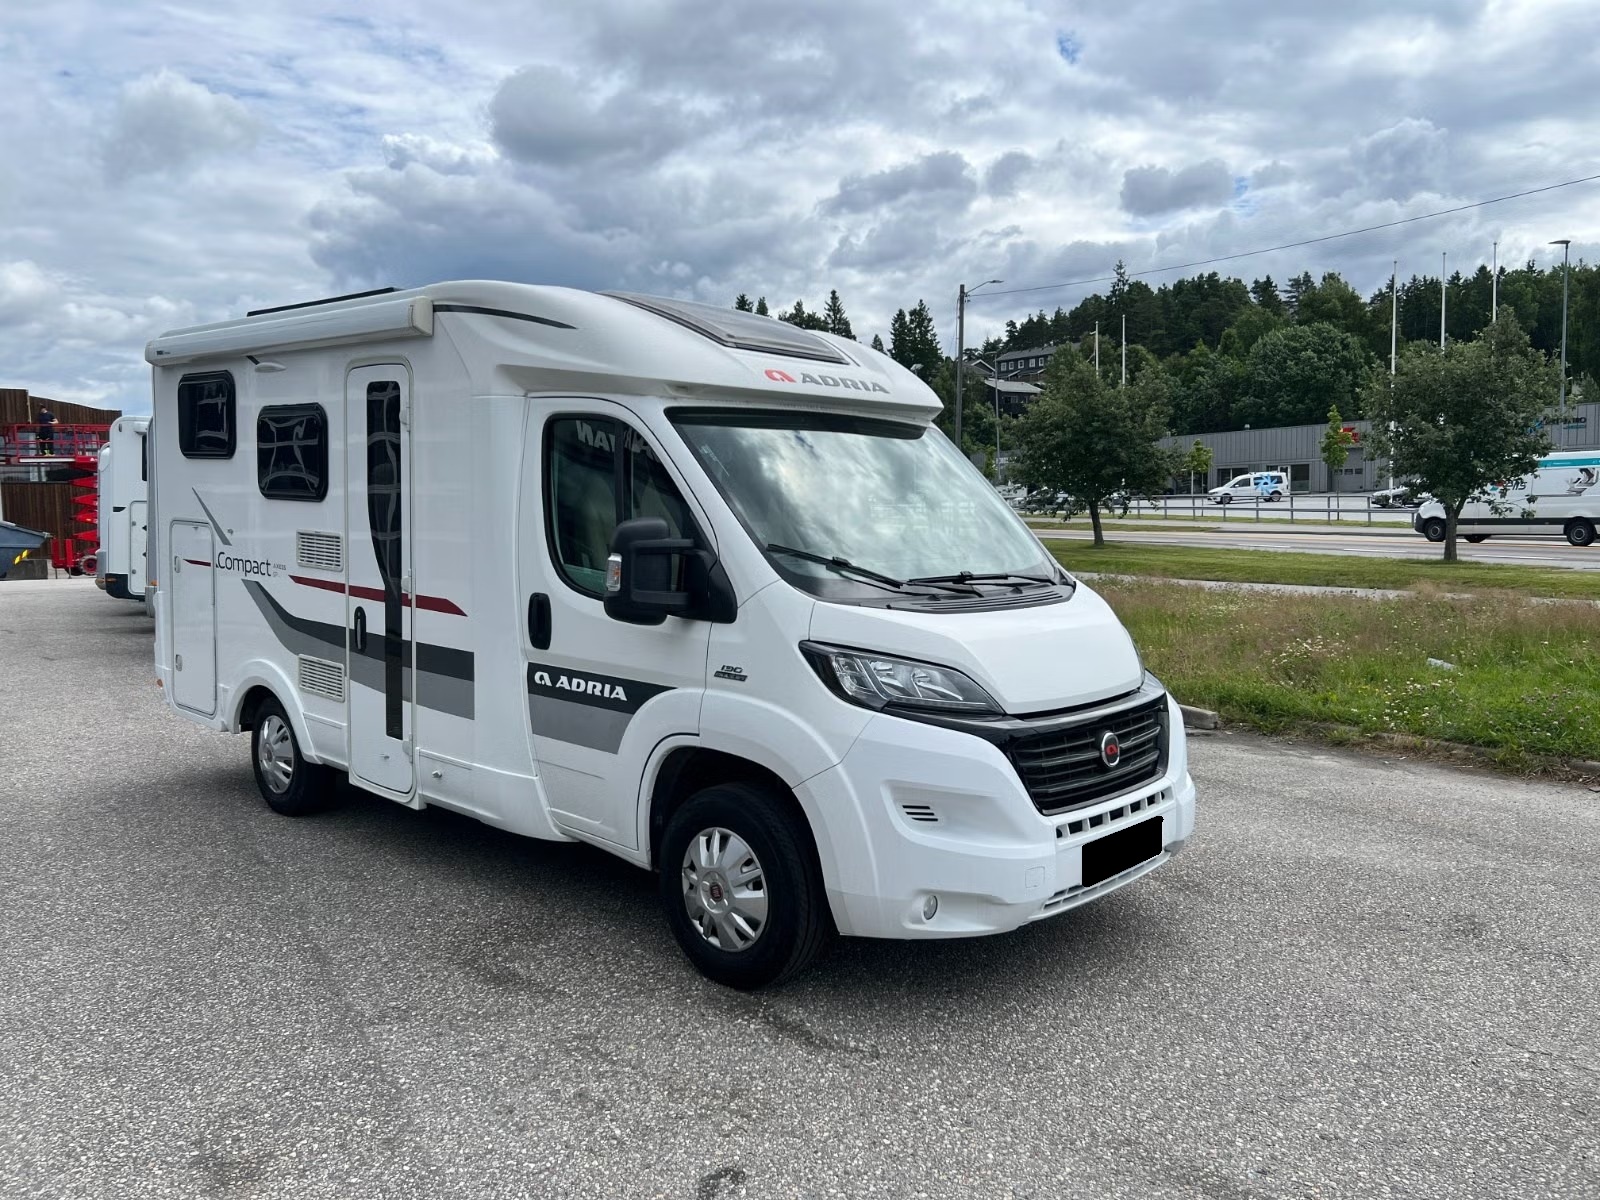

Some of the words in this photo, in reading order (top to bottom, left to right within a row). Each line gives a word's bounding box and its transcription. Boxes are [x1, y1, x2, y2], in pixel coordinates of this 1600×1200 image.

[801, 373, 890, 394] ADRIA
[217, 551, 272, 577] Compact
[556, 675, 628, 702] ADRIA
